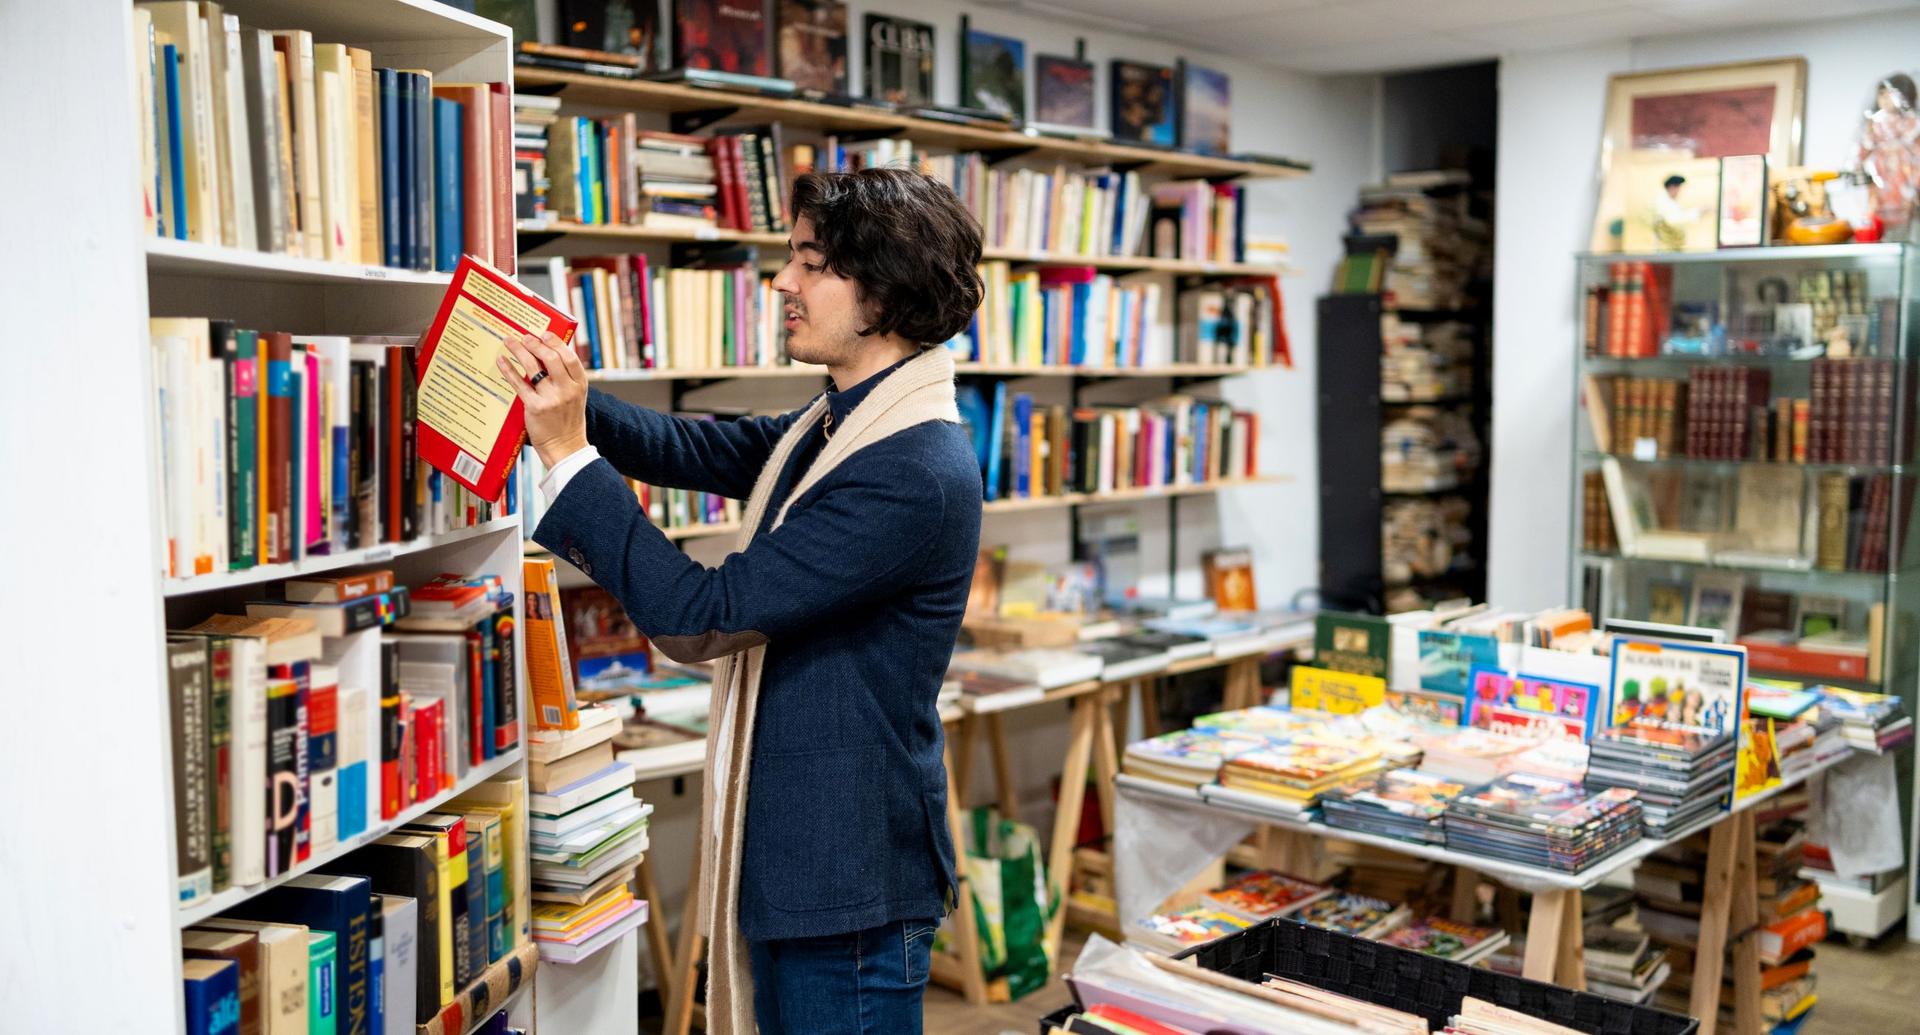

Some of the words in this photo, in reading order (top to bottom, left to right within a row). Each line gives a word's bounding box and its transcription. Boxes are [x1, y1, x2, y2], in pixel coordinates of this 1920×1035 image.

[871, 21, 933, 50] CUBA
[502, 456, 515, 480] CÓMO
[503, 639, 514, 720] DICTIONARY
[184, 708, 197, 808] DICCIONARIO
[187, 812, 198, 858] GRAN
